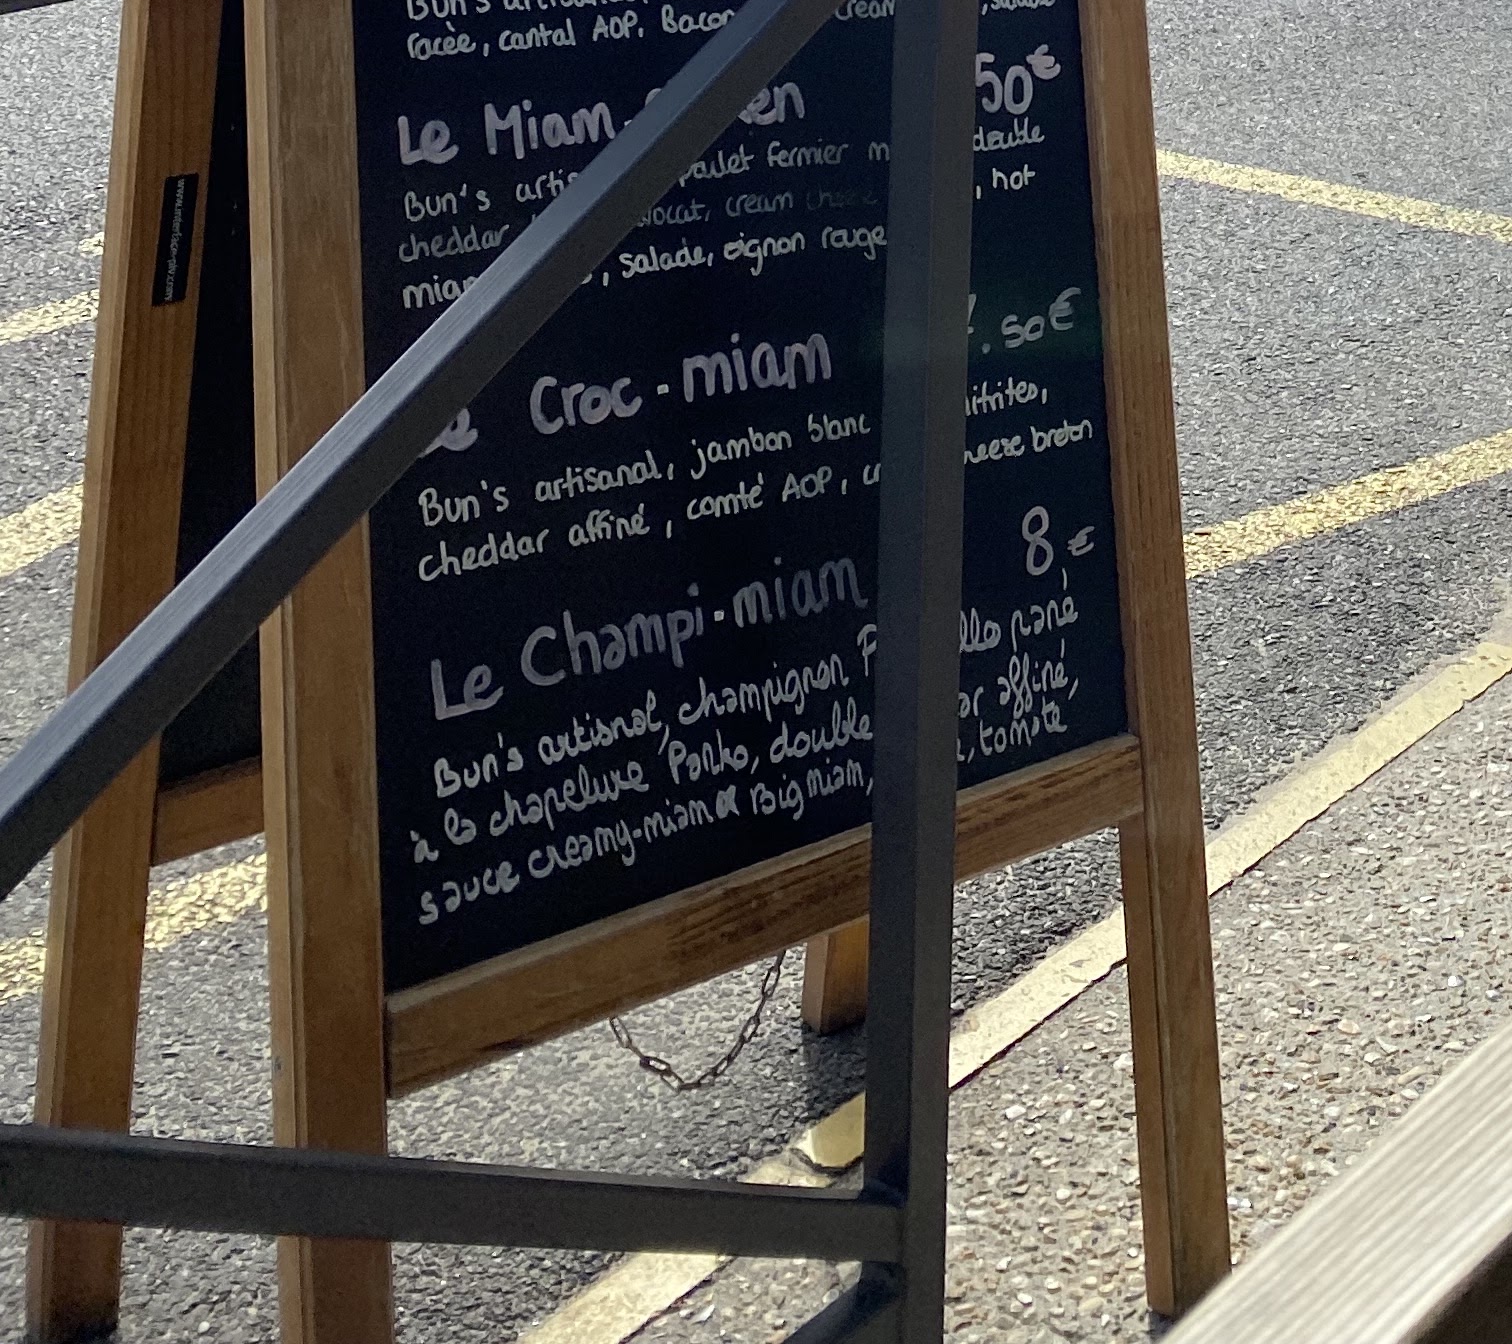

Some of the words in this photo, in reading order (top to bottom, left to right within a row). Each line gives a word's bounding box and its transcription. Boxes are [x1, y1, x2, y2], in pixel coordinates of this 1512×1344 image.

[497, 17, 577, 52] cantal
[397, 114, 460, 166] Le
[398, 223, 511, 263] cheddar
[725, 191, 795, 218] cream
[403, 182, 492, 223] Bun's
[722, 231, 806, 277] oignon
[417, 479, 510, 528] Bun's
[690, 426, 793, 481] jambon
[807, 412, 872, 443] blanc
[418, 528, 550, 582] cheddar
[686, 471, 764, 521] comté
[430, 658, 505, 721] Le
[433, 731, 524, 799] Bun's
[677, 652, 850, 726] champignon
[1010, 567, 1079, 654] pané
[488, 760, 650, 832] chapelure
[769, 695, 874, 764] double
[418, 860, 521, 925] sauce
[750, 773, 805, 822] Big
[980, 695, 1069, 757] tomate
